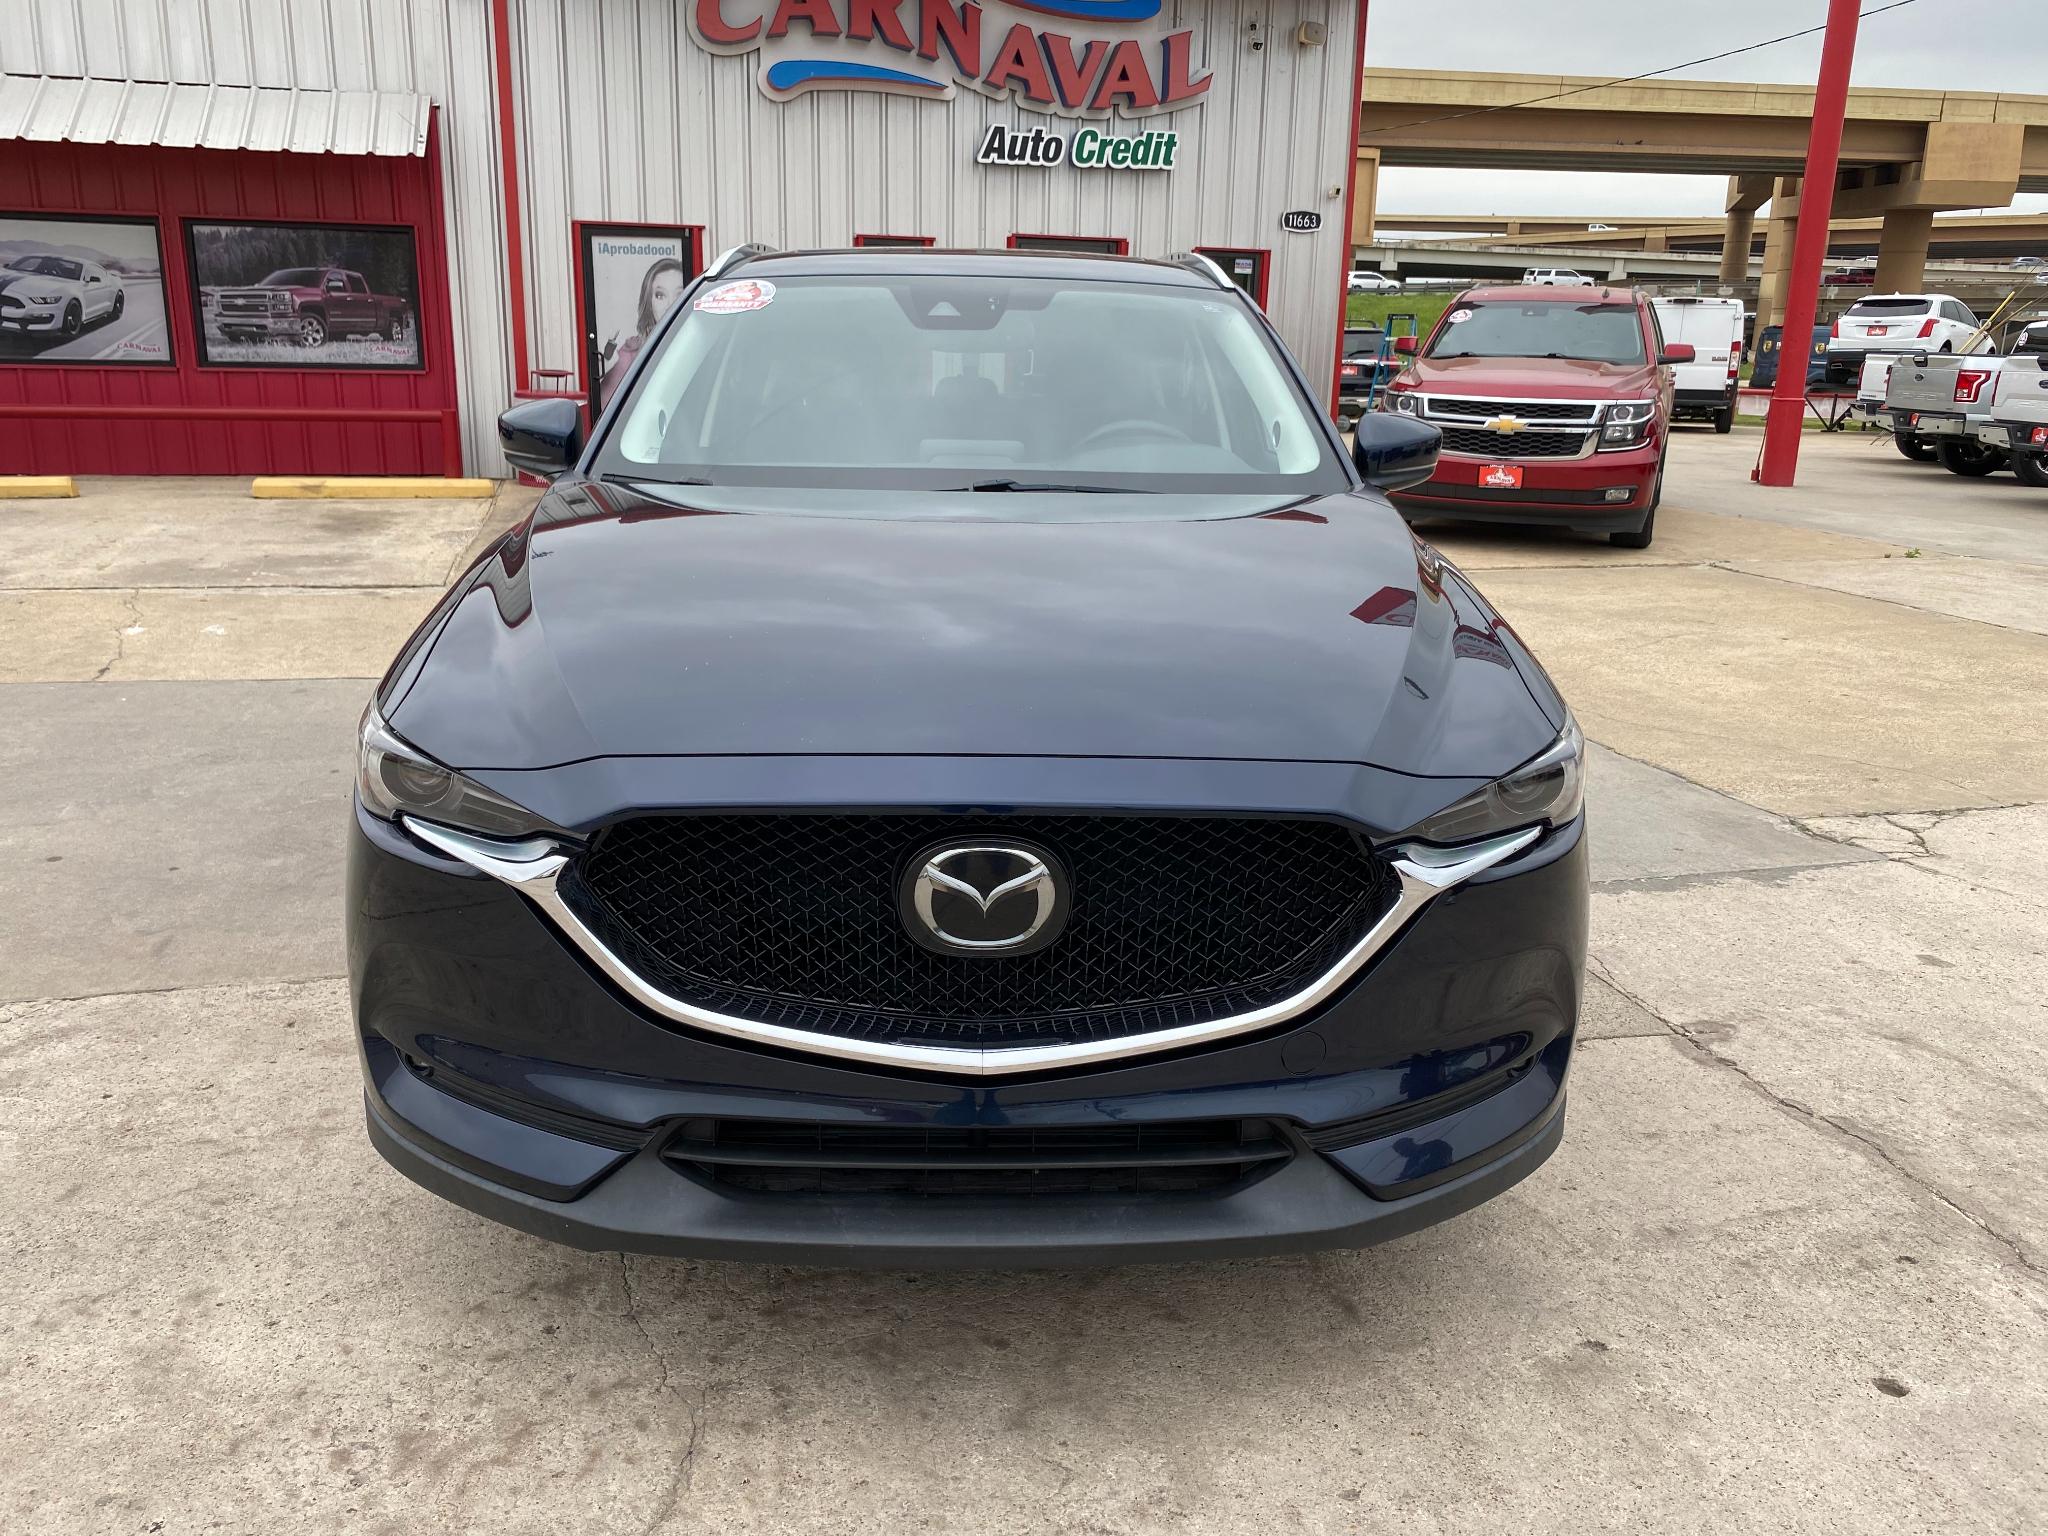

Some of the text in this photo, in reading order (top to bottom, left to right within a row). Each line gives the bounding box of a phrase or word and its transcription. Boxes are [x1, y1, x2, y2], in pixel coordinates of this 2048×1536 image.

[980, 125, 1178, 167] Auto Credit
[1288, 213, 1317, 228] 11663
[598, 242, 676, 257] ¡Aprobadooo!
[117, 340, 162, 353] CARNAVAL
